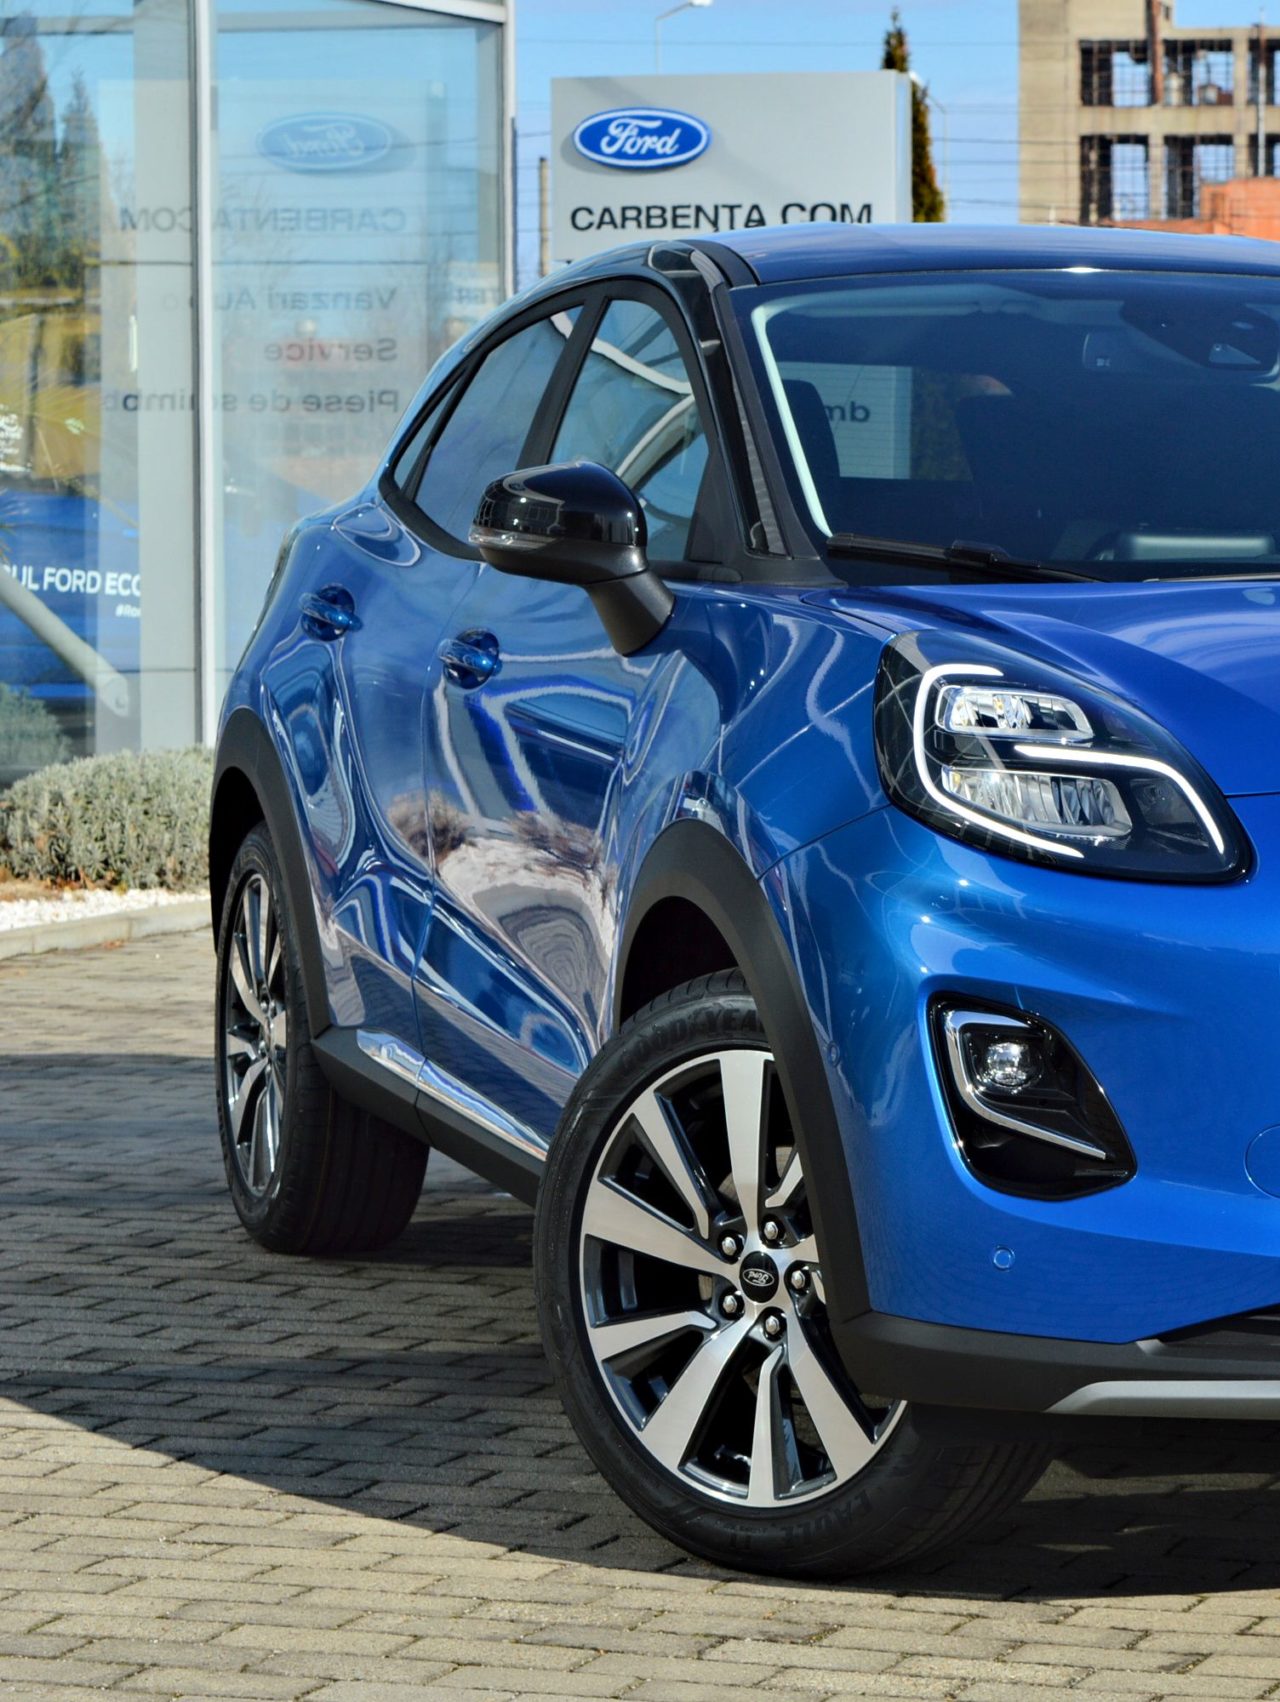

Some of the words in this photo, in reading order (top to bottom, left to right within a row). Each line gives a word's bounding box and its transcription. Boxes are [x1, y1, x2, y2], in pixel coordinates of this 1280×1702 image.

[600, 117, 682, 155] Ford
[570, 204, 767, 233] CARBENTA
[781, 203, 872, 224] COM
[43, 566, 102, 594] FORD
[747, 1270, 770, 1285] Ford
